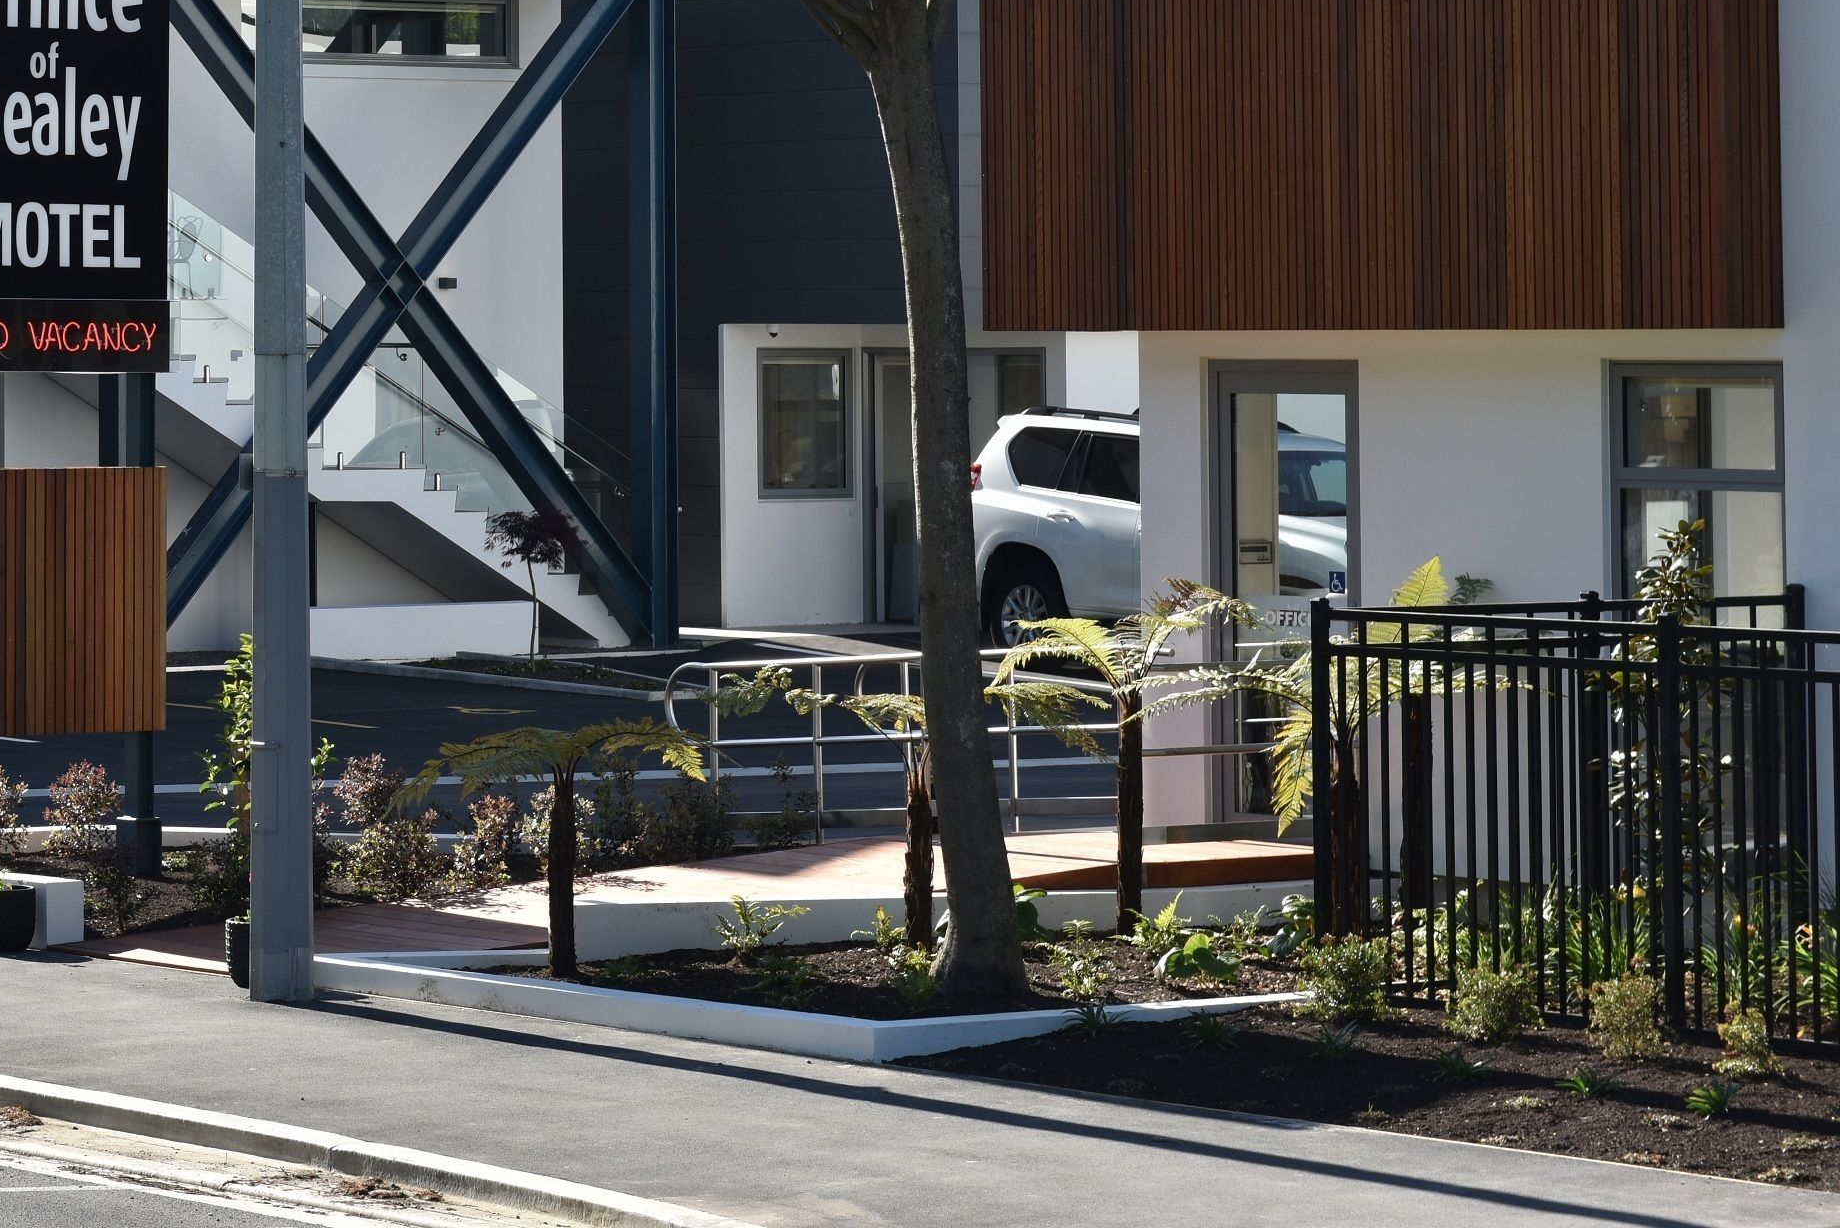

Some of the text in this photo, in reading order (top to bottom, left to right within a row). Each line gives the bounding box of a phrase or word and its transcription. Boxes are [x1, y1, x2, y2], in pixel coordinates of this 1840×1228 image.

[30, 41, 60, 80] of
[28, 321, 157, 352] VACANCY
[1265, 610, 1311, 627] OFFIC
